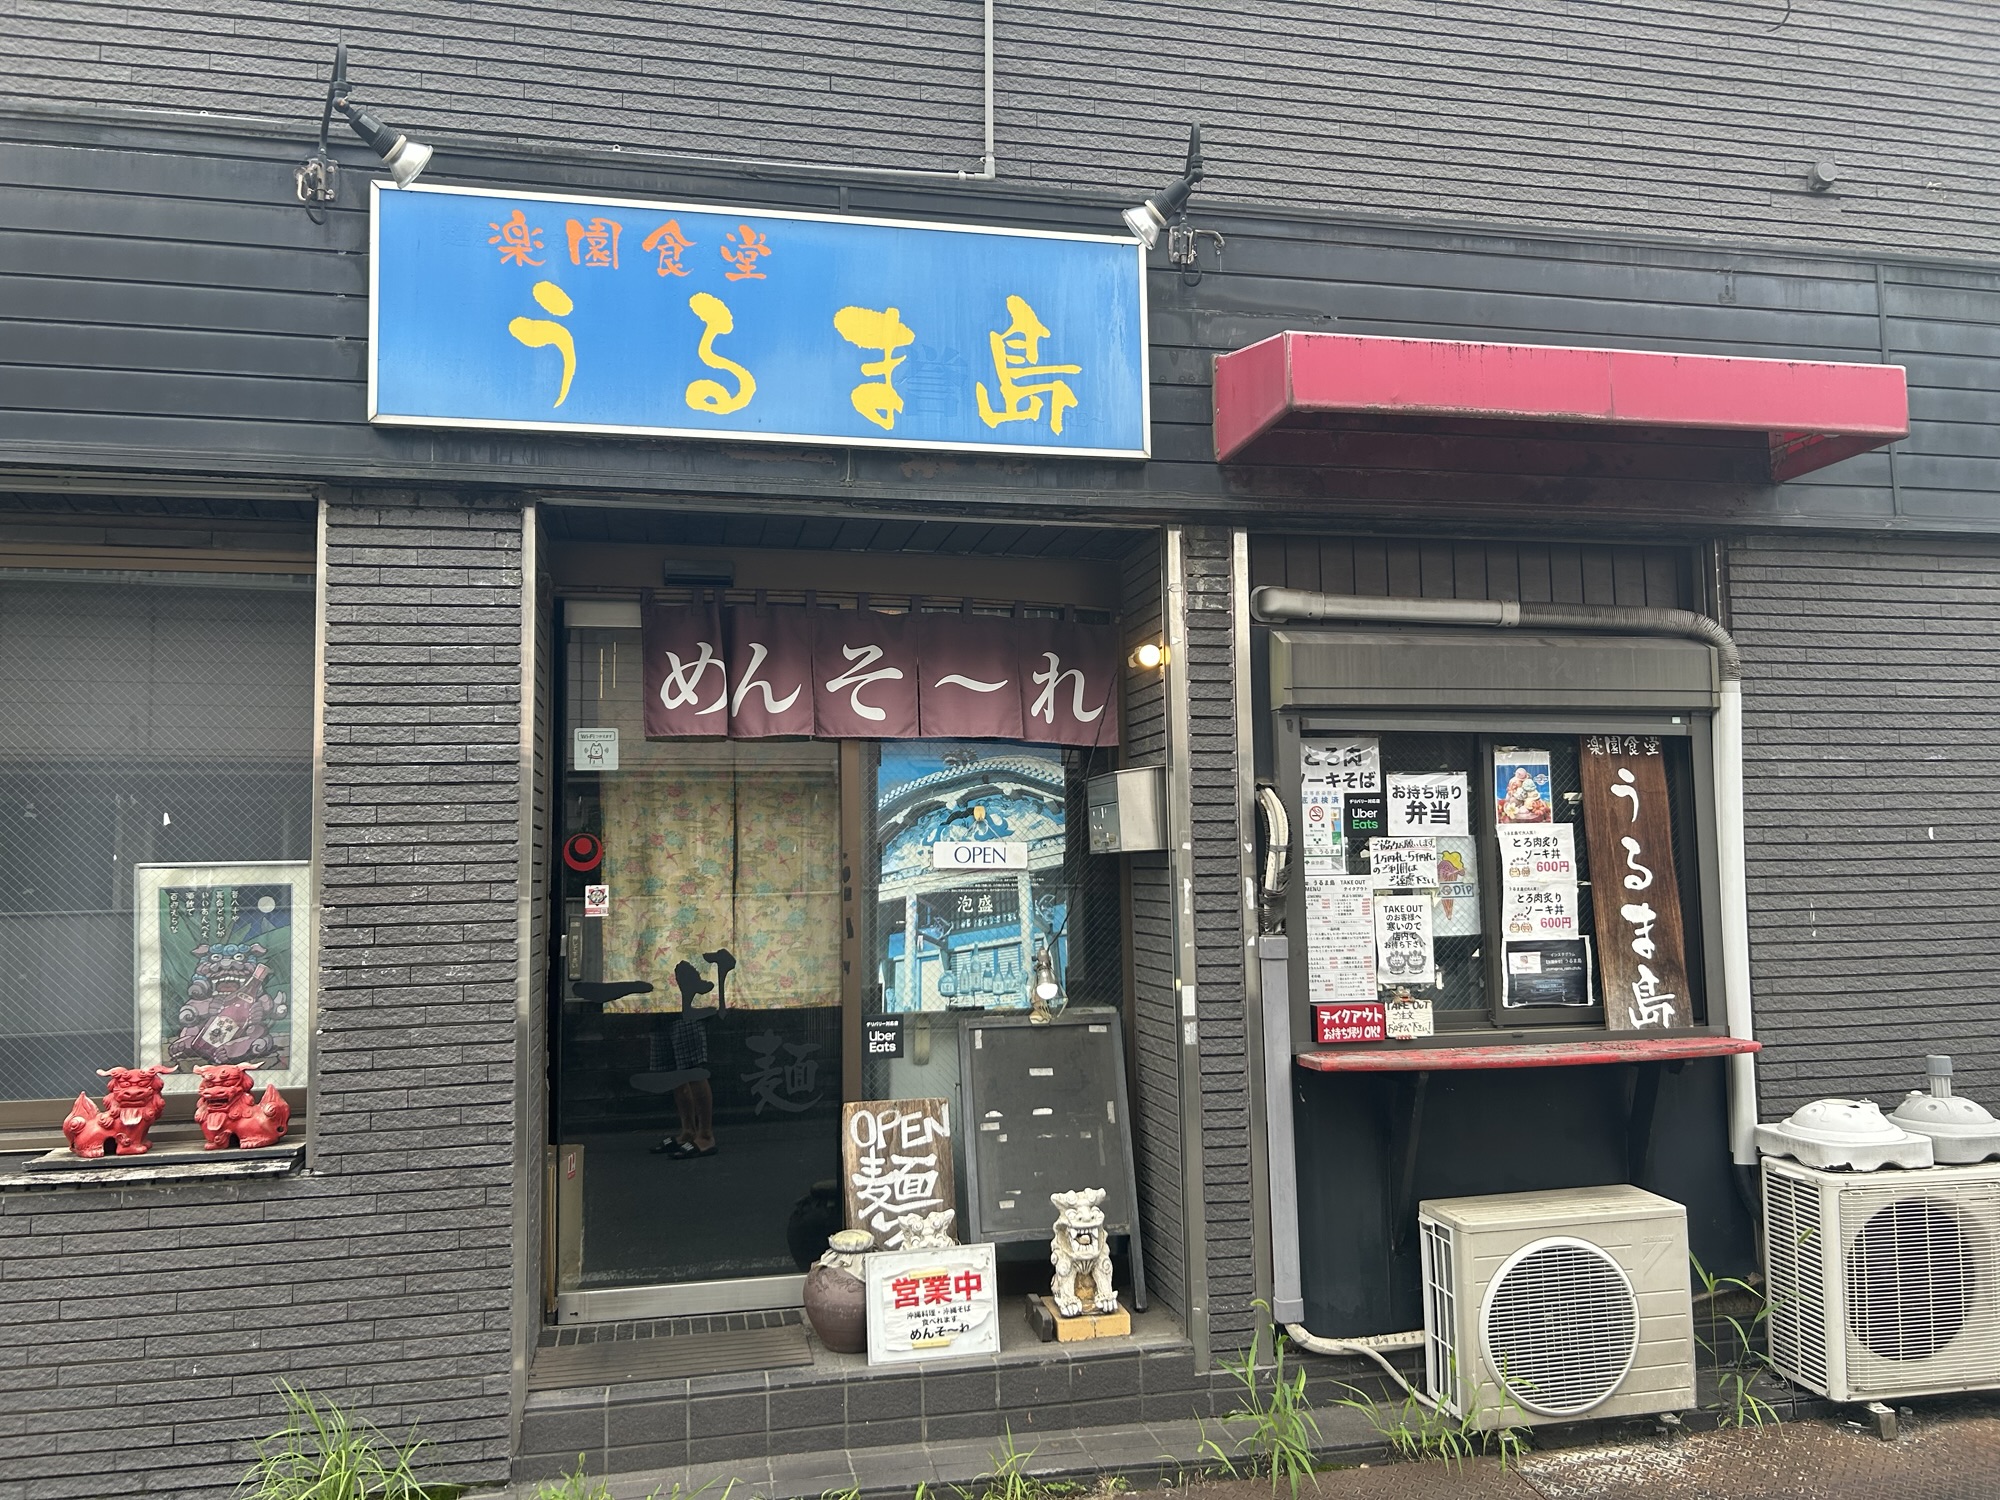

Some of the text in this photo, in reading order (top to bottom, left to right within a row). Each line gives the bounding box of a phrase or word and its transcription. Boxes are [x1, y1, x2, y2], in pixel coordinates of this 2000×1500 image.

[488, 209, 772, 282] 楽園食堂
[508, 280, 1084, 435] うるま島
[1587, 736, 1660, 756] 楽園食堂
[1392, 784, 1462, 800] お持ち帰り
[1351, 808, 1378, 819] Uber
[1405, 800, 1451, 825] 弁当
[1352, 819, 1379, 830] Eats
[1513, 837, 1558, 848] とろ肉炙り
[953, 845, 1007, 864] OPEN
[1525, 849, 1561, 859] ソーキ丼
[1373, 862, 1418, 874] のご利用は
[1536, 861, 1570, 873] 600円
[957, 894, 994, 913] 泡盛
[1517, 893, 1562, 904] とろ肉炙り
[1610, 767, 1676, 1030] うるま島
[1383, 904, 1424, 913] TAKE OUT
[1525, 905, 1565, 916] ソーキ丼
[1386, 913, 1422, 922] のお客様へ
[1540, 916, 1572, 928] 600円
[1386, 922, 1422, 931] 寒いので
[1392, 931, 1418, 941] 店内で
[1384, 940, 1427, 949] お待ち下さい
[1320, 1008, 1383, 1025] テイクアウト
[868, 1030, 897, 1042] Uber
[1324, 1025, 1381, 1041] お持ち帰り OK!
[869, 1041, 897, 1053] Eats
[850, 1103, 950, 1149] OPEN
[852, 1145, 944, 1219] 麺
[891, 1270, 983, 1310] 営業中
[906, 1305, 972, 1320] 沖縄料理・沖縄そば
[921, 1315, 957, 1327] 食べれます
